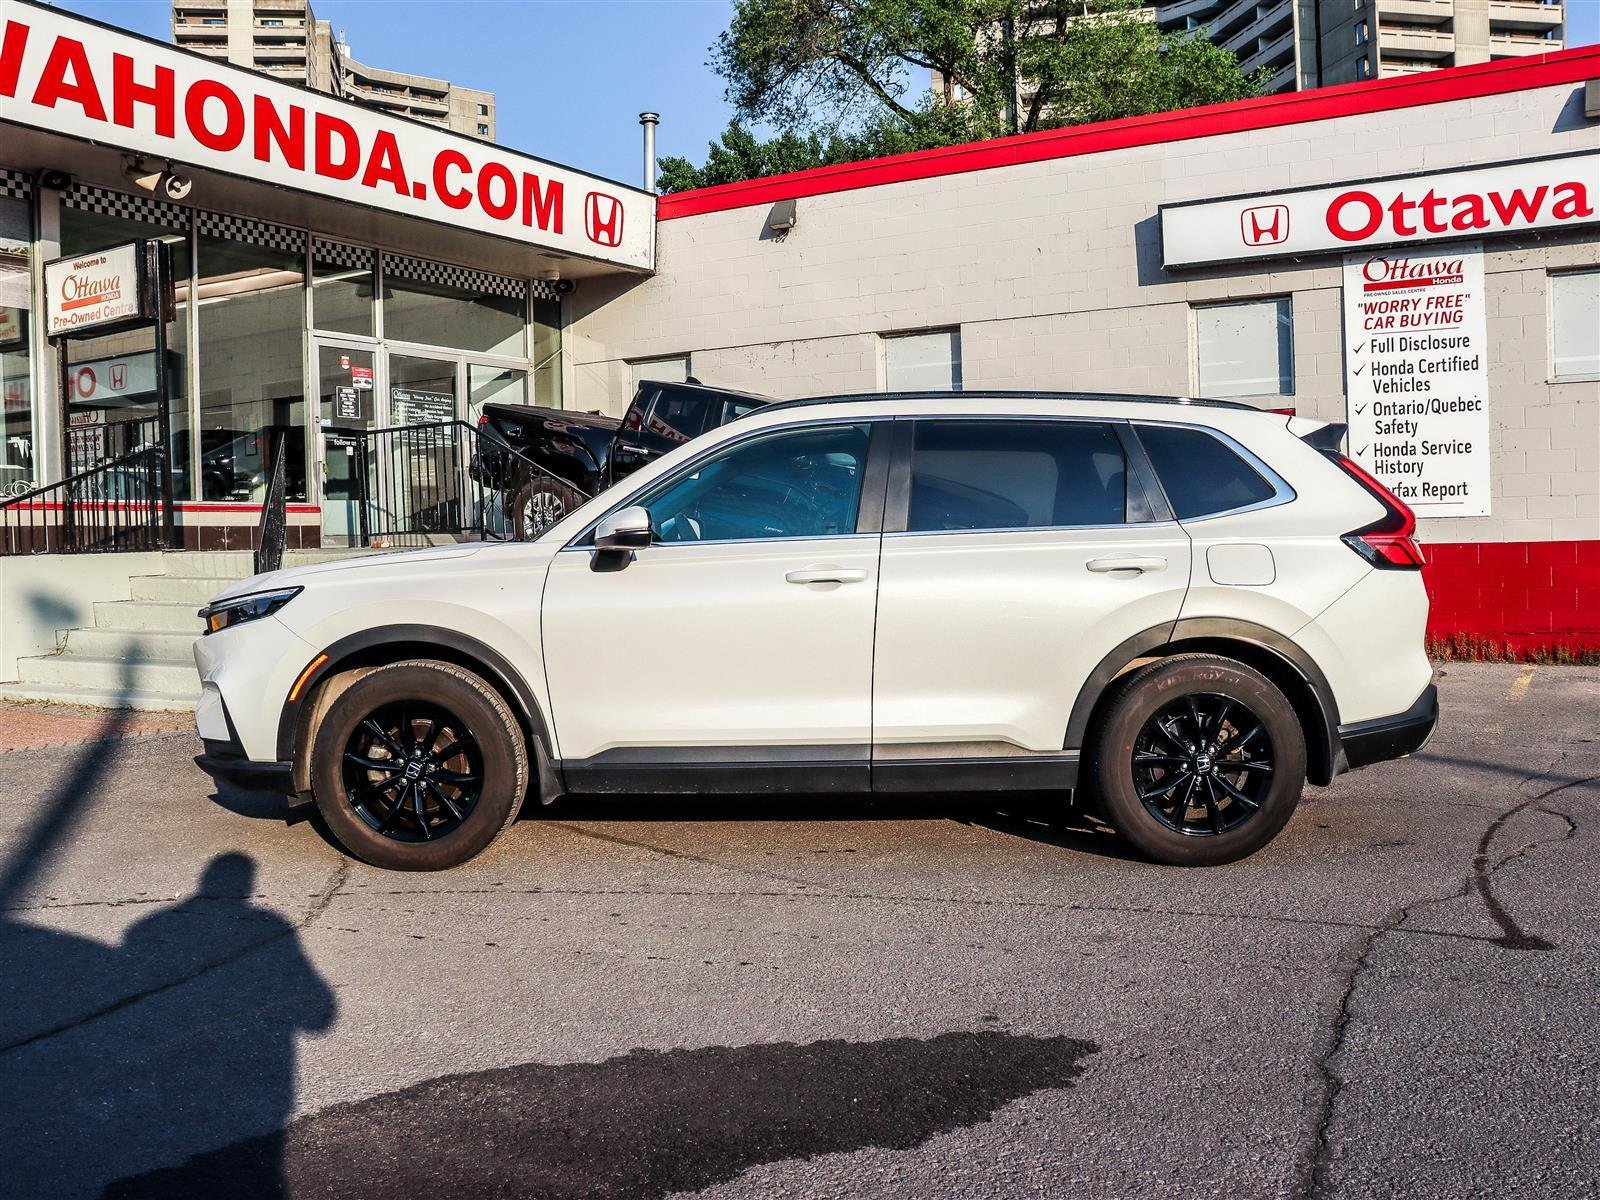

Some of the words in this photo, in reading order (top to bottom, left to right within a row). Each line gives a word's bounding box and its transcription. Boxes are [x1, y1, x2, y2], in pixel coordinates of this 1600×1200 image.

[1326, 181, 1593, 241] Ottawa
[73, 259, 99, 271] Welcome
[100, 256, 106, 264] to
[1363, 255, 1463, 281] Ottawa
[62, 274, 120, 301] Ottawa
[1432, 275, 1462, 285] Honda
[101, 290, 120, 301] HONDA
[1358, 297, 1421, 315] "WORRY
[1426, 293, 1471, 310] FREE"
[53, 309, 101, 328] Pre-Owned
[103, 303, 134, 317] Centre
[1364, 315, 1395, 330] CAR
[1399, 310, 1463, 328] BUYING
[1371, 337, 1394, 353] Full
[1399, 335, 1470, 352] Disclosure
[1372, 359, 1414, 376] Honda
[1419, 354, 1479, 373] Certified
[1373, 377, 1431, 394] Vehicles
[1373, 396, 1481, 416] Ontario/Quebec
[1375, 419, 1418, 437] Safety
[1374, 440, 1416, 457] Honda
[1421, 439, 1472, 455] Service
[1375, 460, 1424, 477] History
[1422, 481, 1468, 500] Report
